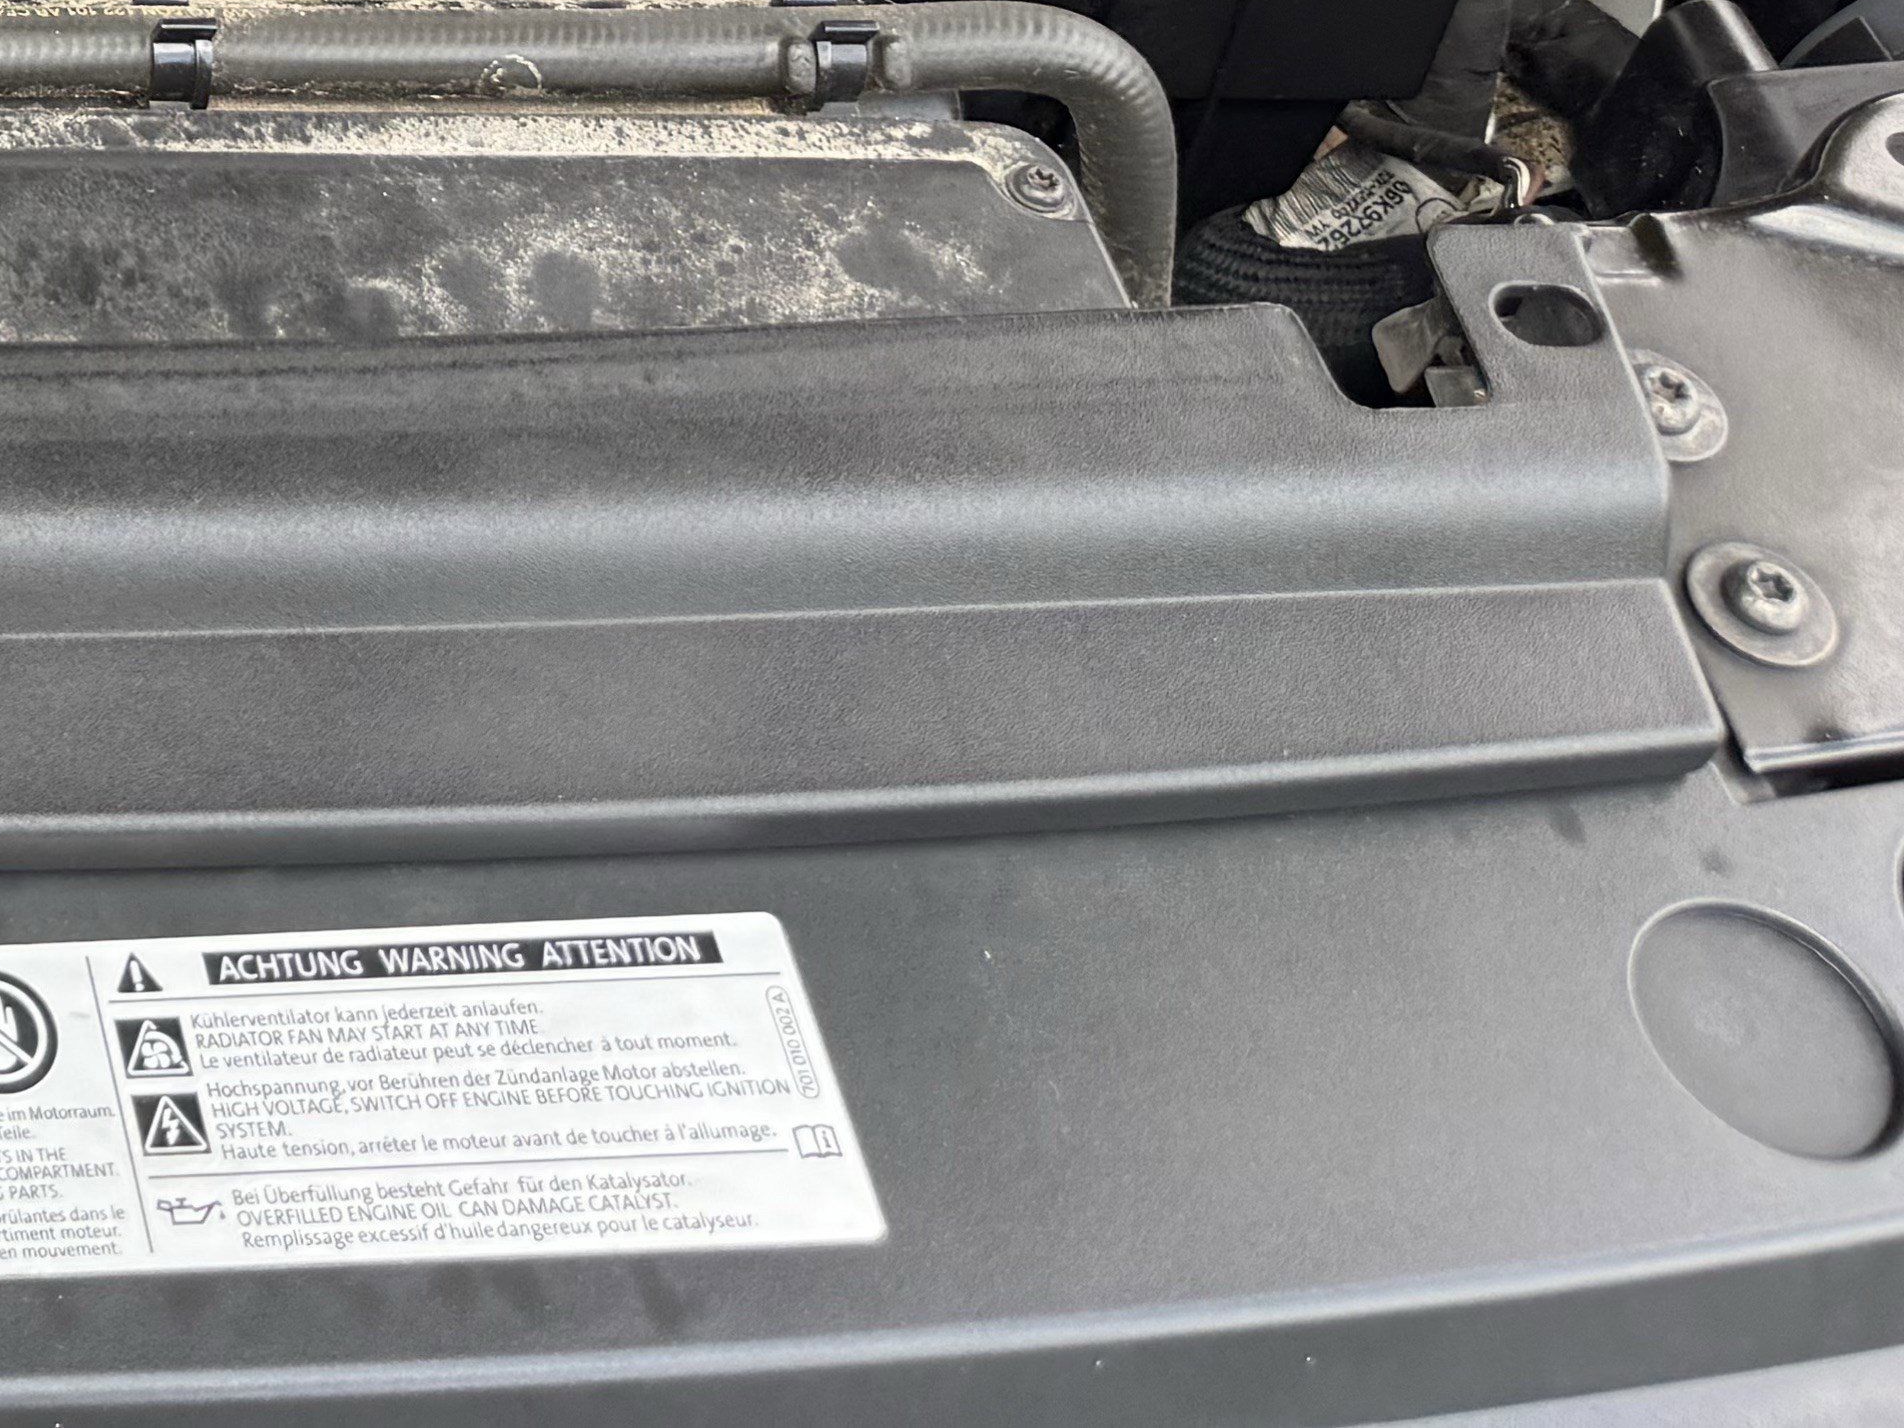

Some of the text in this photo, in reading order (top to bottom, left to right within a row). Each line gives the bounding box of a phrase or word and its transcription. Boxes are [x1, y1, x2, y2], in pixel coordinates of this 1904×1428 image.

[219, 935, 701, 981] ACHTUNG WARNING ATTENTION
[194, 1029, 284, 1050] RADIATOR
[287, 1028, 324, 1045] FAN
[326, 1026, 367, 1044] MAY
[371, 1023, 423, 1043] START
[429, 1022, 449, 1039] AT
[454, 1021, 490, 1038] ANY
[210, 1078, 791, 1119] HIGH VOLTAGE, SWITCH OFF ENGINE BEFORE TOUCHING IGNITION
[6, 1109, 27, 1122] im
[28, 1105, 116, 1121] Motorraum.
[215, 1119, 293, 1140] SYSTEM.
[15, 1149, 34, 1163] IN
[35, 1146, 69, 1165] THE
[8, 1183, 64, 1200] PARTS.
[68, 1206, 109, 1223] dans
[110, 1204, 126, 1220] le
[236, 1192, 679, 1228] OVERFILLED ENGINE OIL CAN DAMAGE CATALYST.
[60, 1225, 122, 1240] moteur.
[21, 1241, 123, 1259] mouvement.
